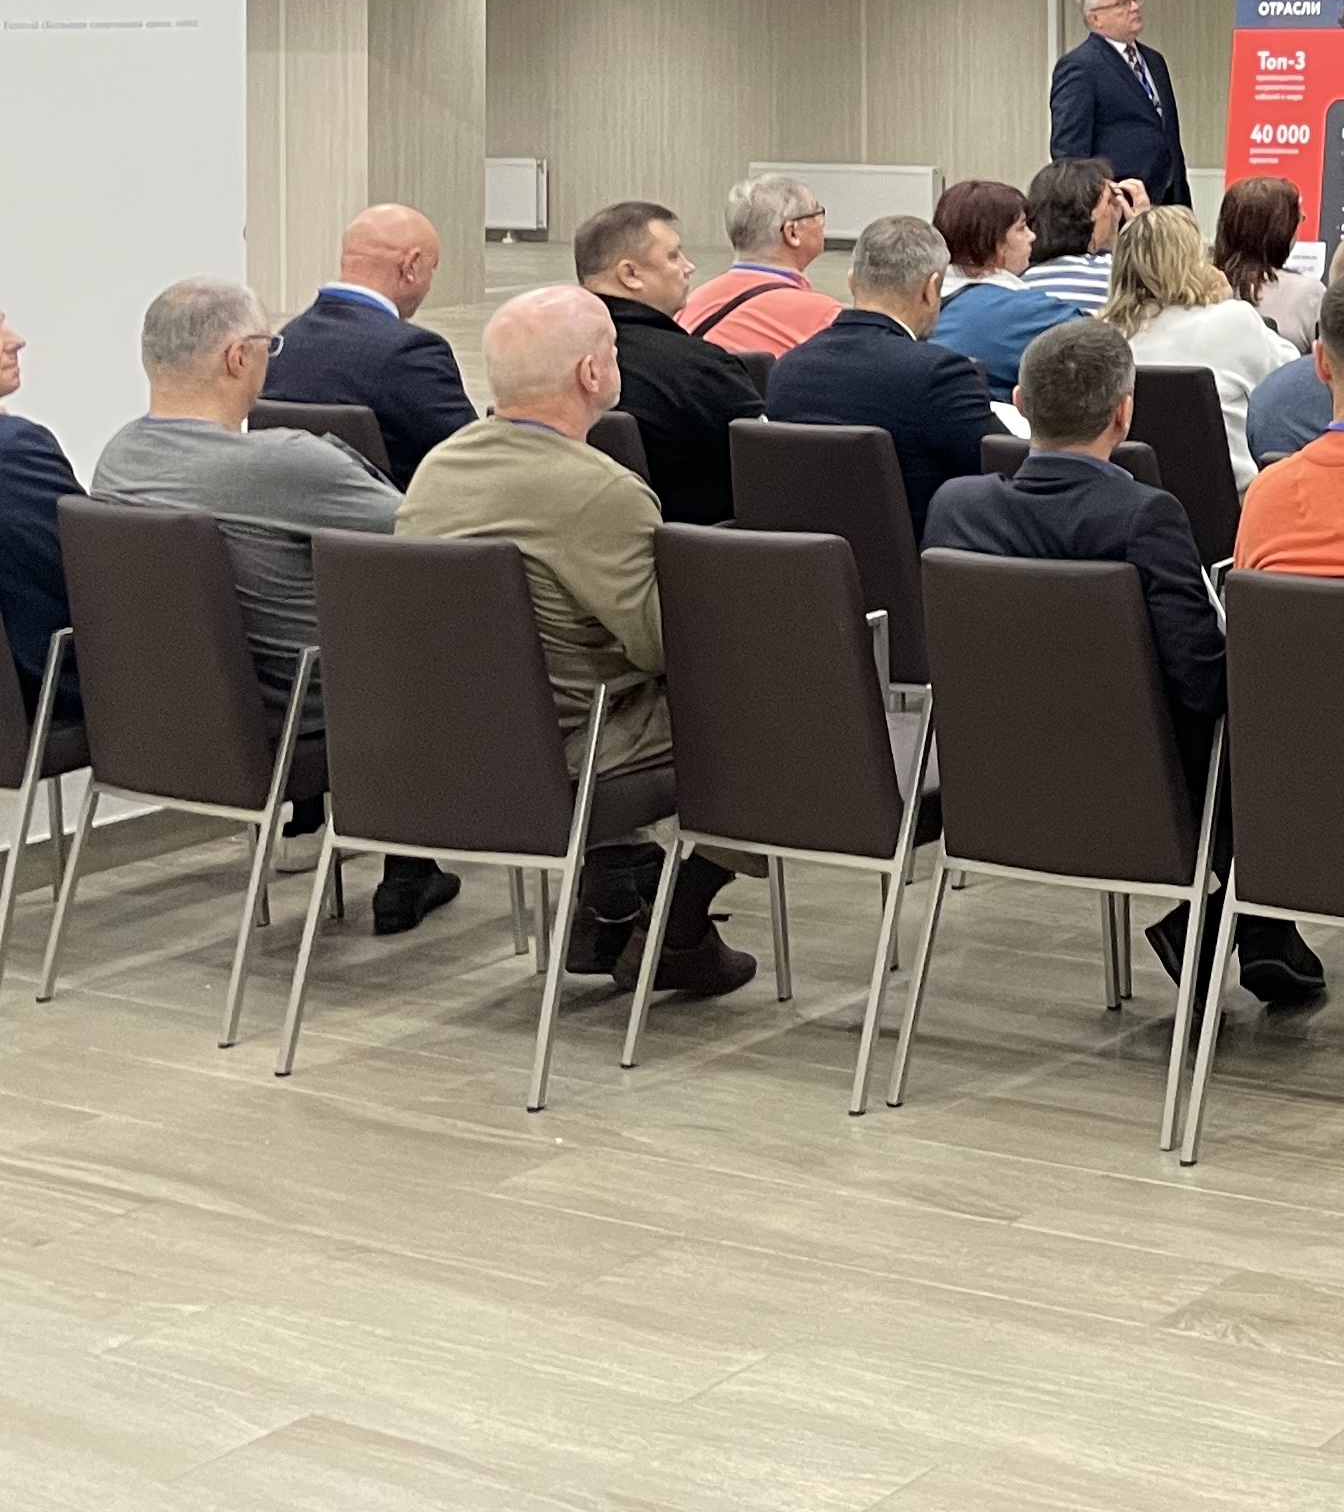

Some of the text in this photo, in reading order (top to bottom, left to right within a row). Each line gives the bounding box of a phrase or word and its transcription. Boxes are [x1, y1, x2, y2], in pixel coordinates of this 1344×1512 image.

[1257, 1, 1322, 17] ОТРАСЛИ
[1256, 50, 1306, 71] Топ-3
[1249, 124, 1310, 145] 40 000
